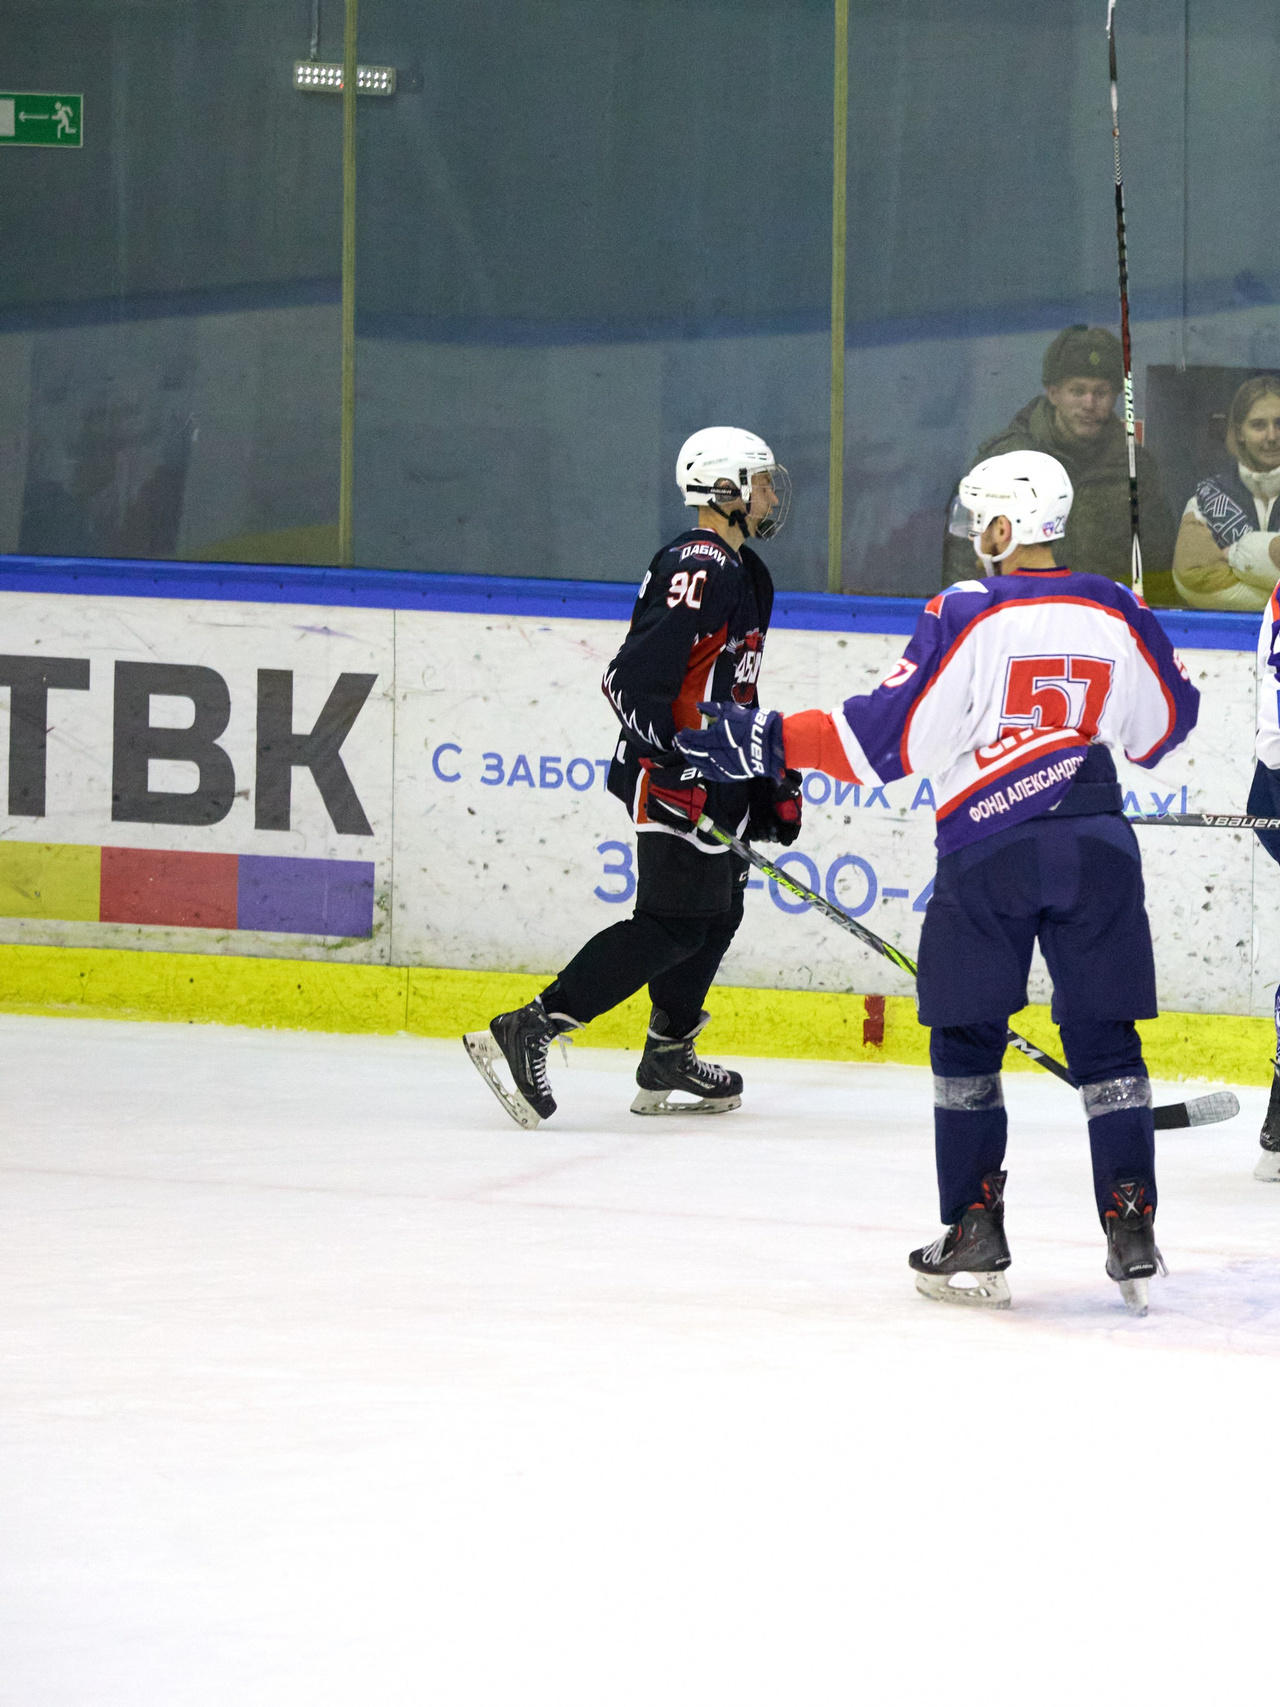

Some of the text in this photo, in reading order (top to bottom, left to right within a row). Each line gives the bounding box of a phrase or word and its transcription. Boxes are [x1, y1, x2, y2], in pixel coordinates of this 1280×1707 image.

[667, 570, 707, 609] 90
[998, 653, 1116, 743] 57
[0, 655, 378, 836] ТВК
[432, 742, 463, 783] С
[968, 791, 1011, 822] ФОНД
